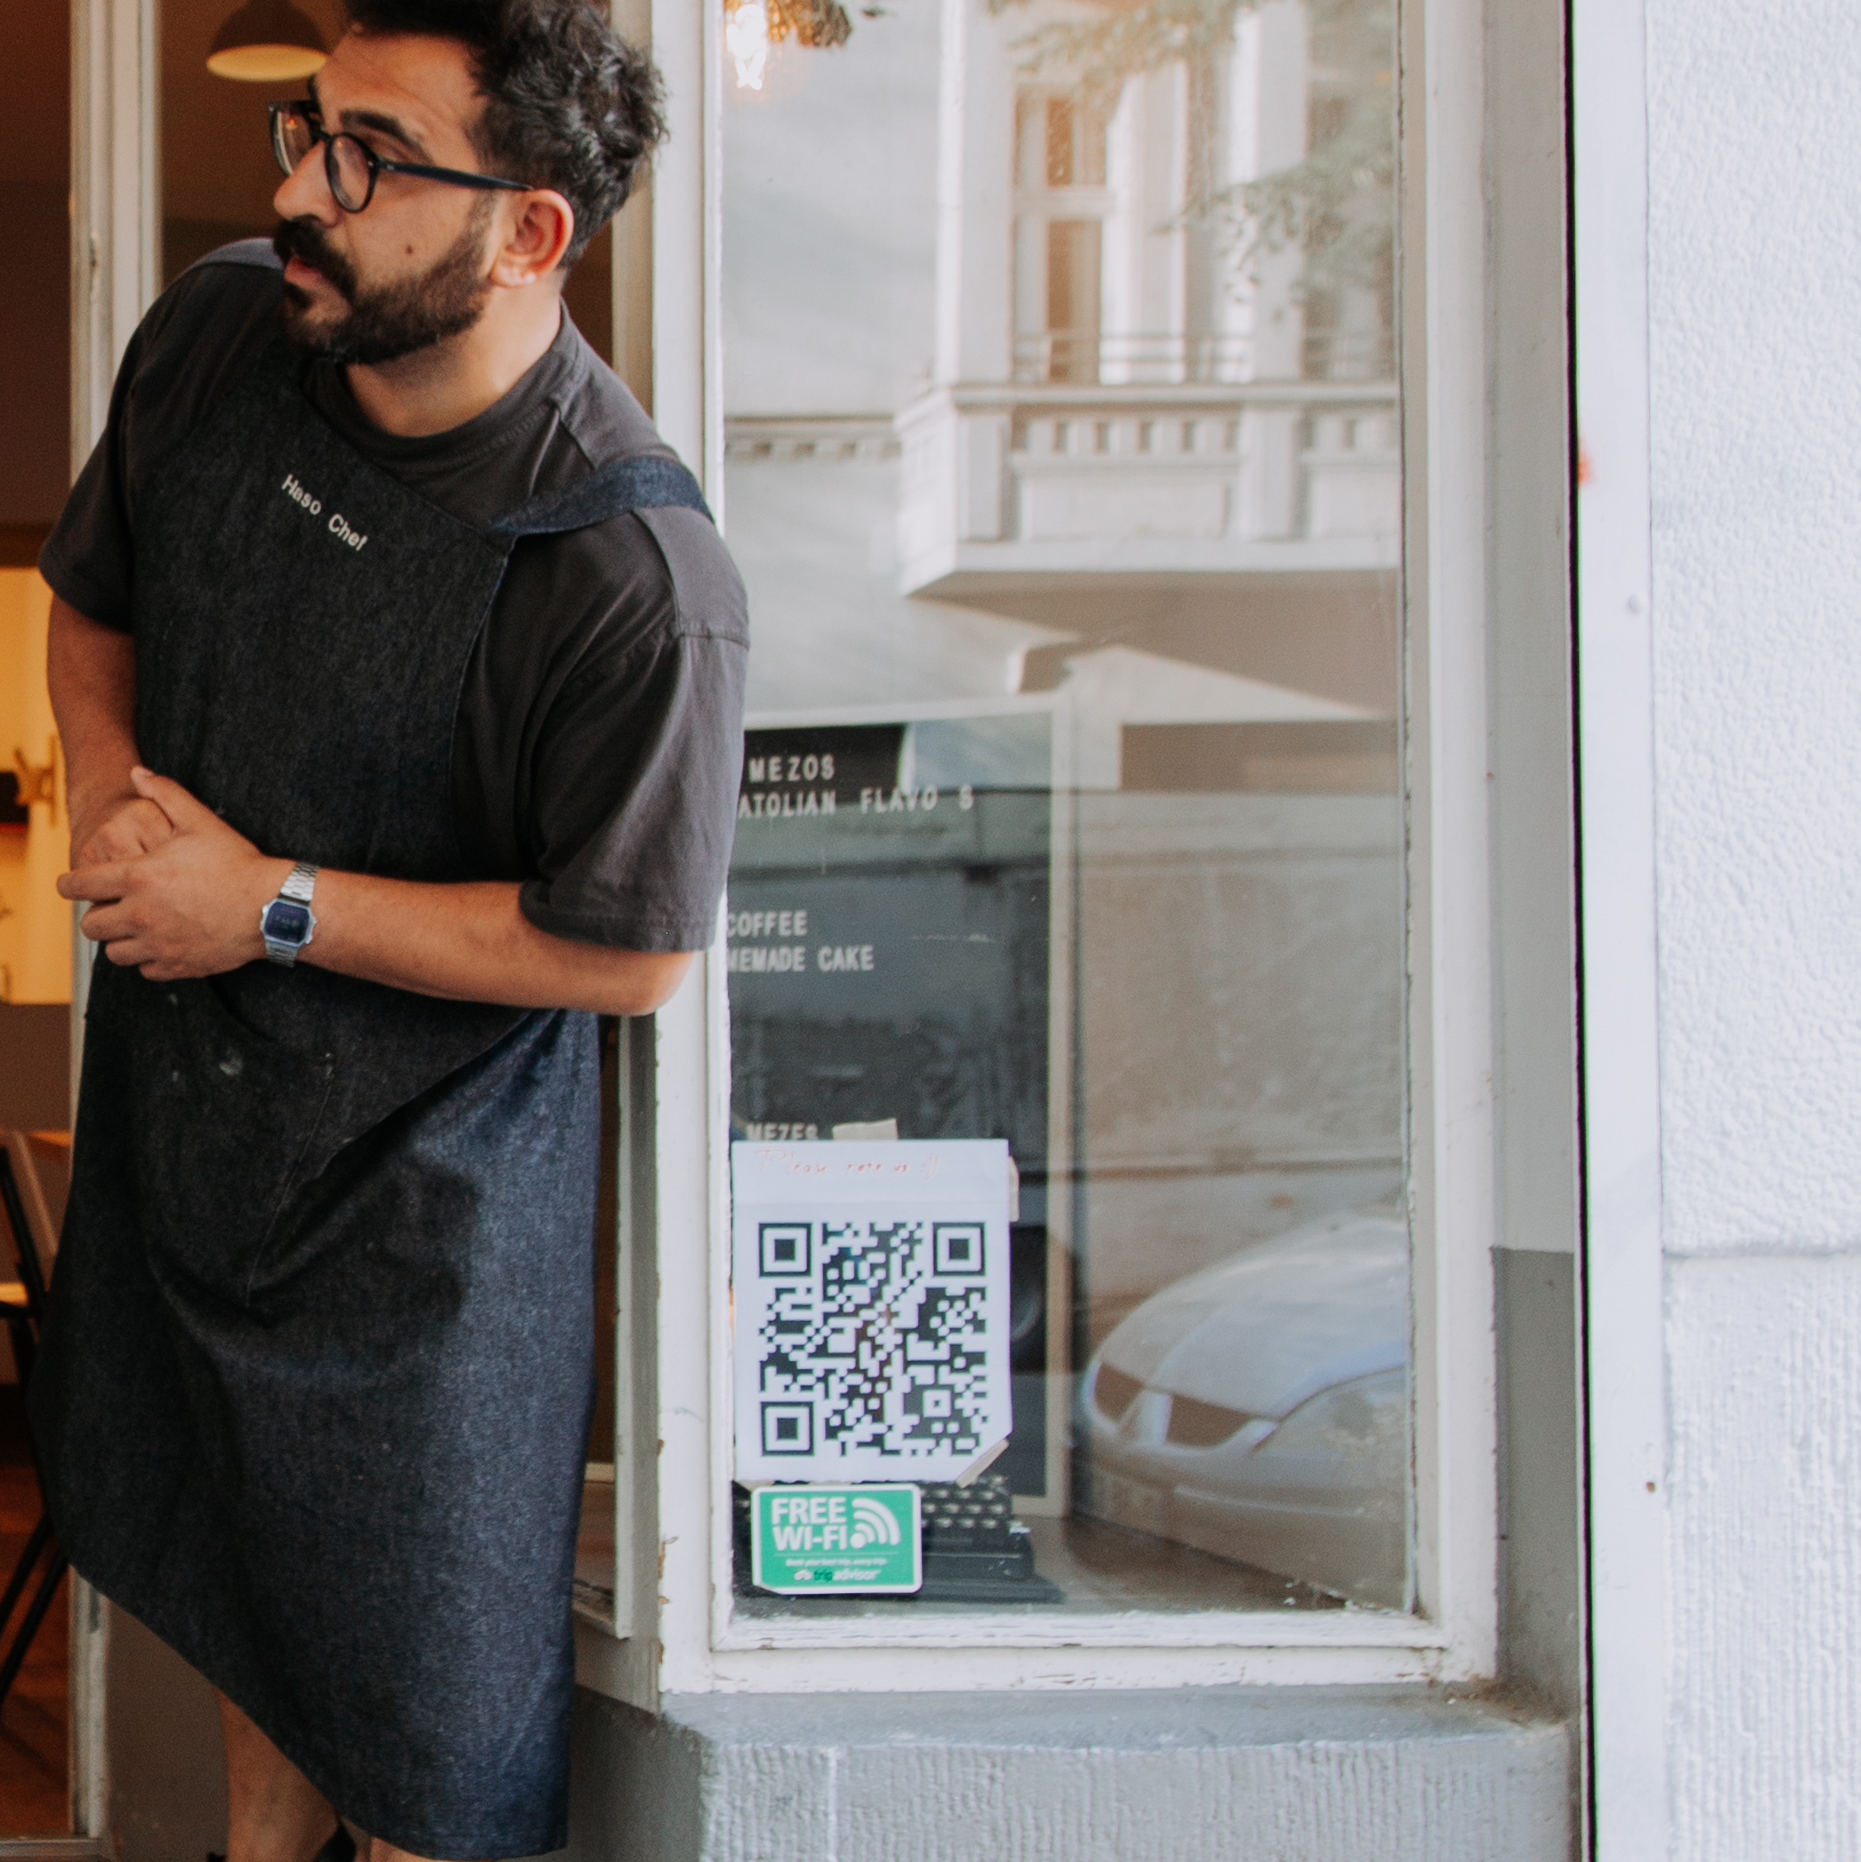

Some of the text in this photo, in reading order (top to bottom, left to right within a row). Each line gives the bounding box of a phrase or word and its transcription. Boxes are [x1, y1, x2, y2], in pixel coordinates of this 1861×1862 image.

[281, 472, 368, 551] Haso Chef
[747, 753, 836, 783] MEZOS
[727, 909, 809, 938] COFFEE
[817, 944, 875, 972] CAKE
[772, 1496, 847, 1525] FREE
[773, 1525, 847, 1551] WI-FI
